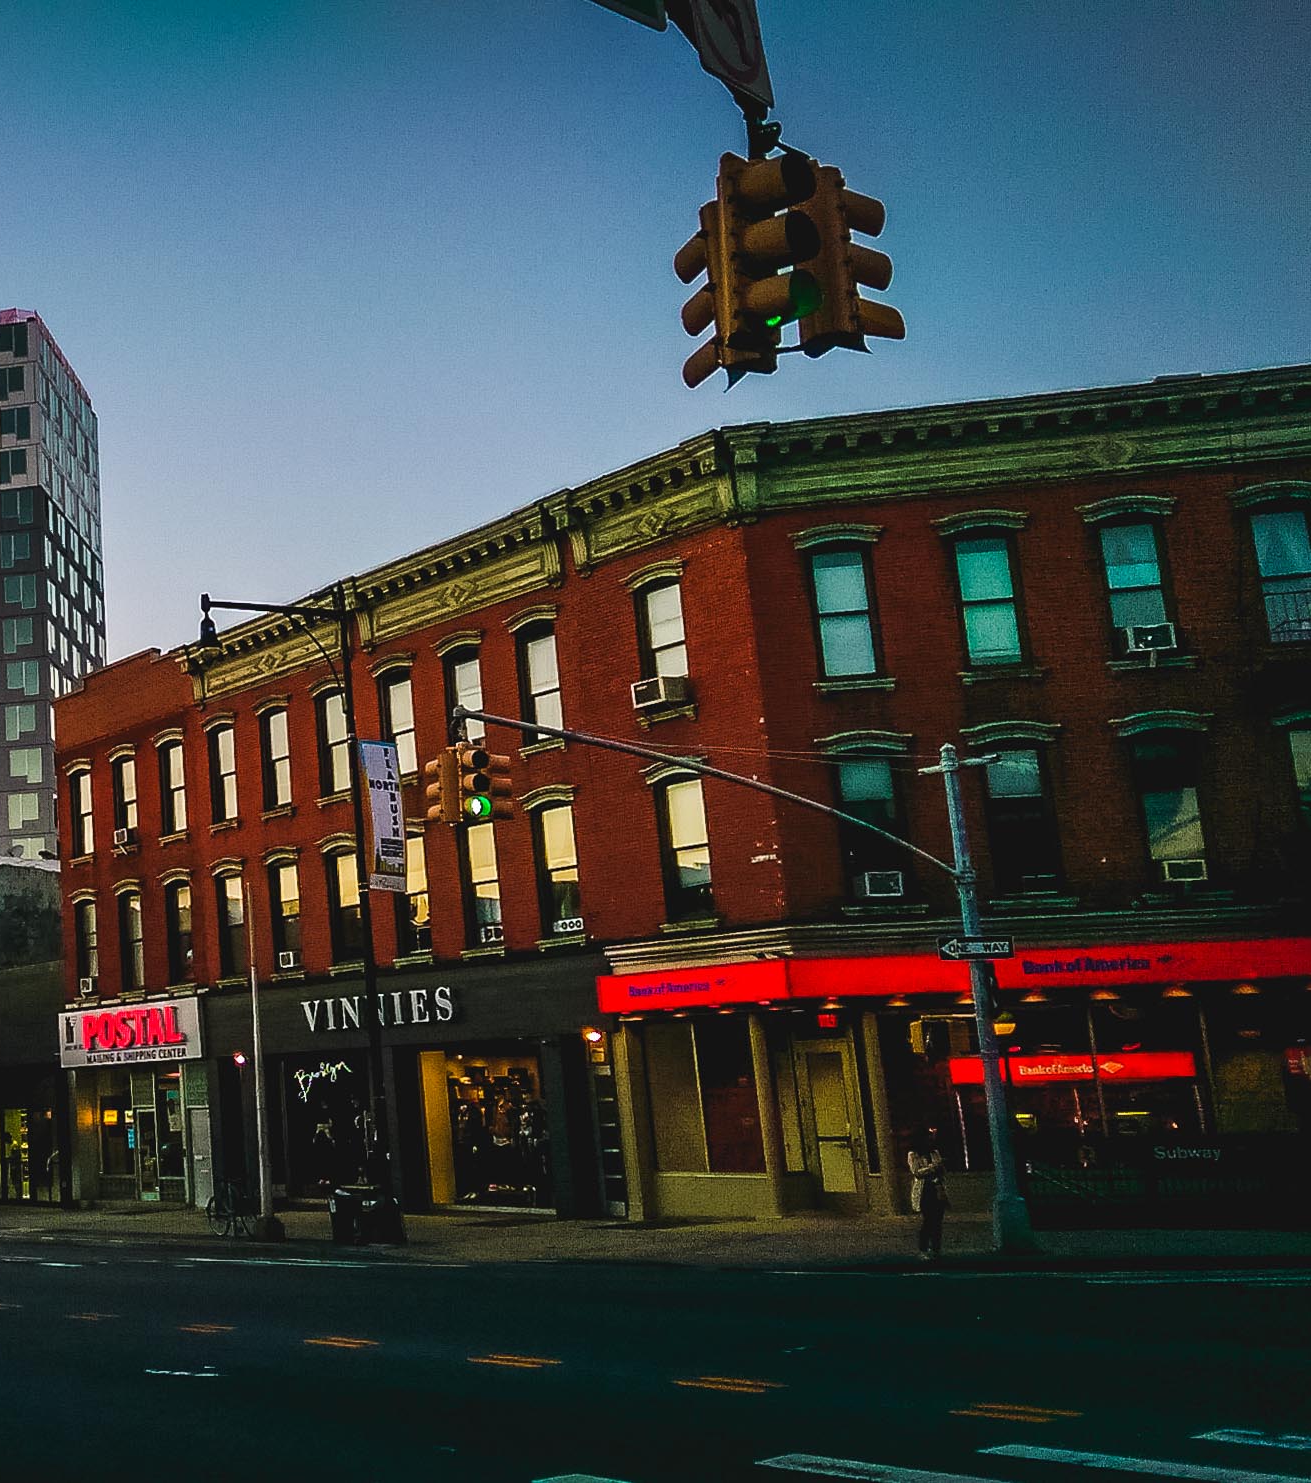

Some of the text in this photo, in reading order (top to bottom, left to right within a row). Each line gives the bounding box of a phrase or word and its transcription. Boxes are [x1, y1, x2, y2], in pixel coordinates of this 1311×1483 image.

[949, 942, 1005, 954] ONE WAY
[1022, 957, 1150, 974] Bank of America
[82, 1006, 187, 1050] POSTAL
[86, 1048, 187, 1064] MAILING & SHIPPING CENTER
[1018, 1065, 1046, 1075] Bank
[1153, 1146, 1222, 1161] Subway
